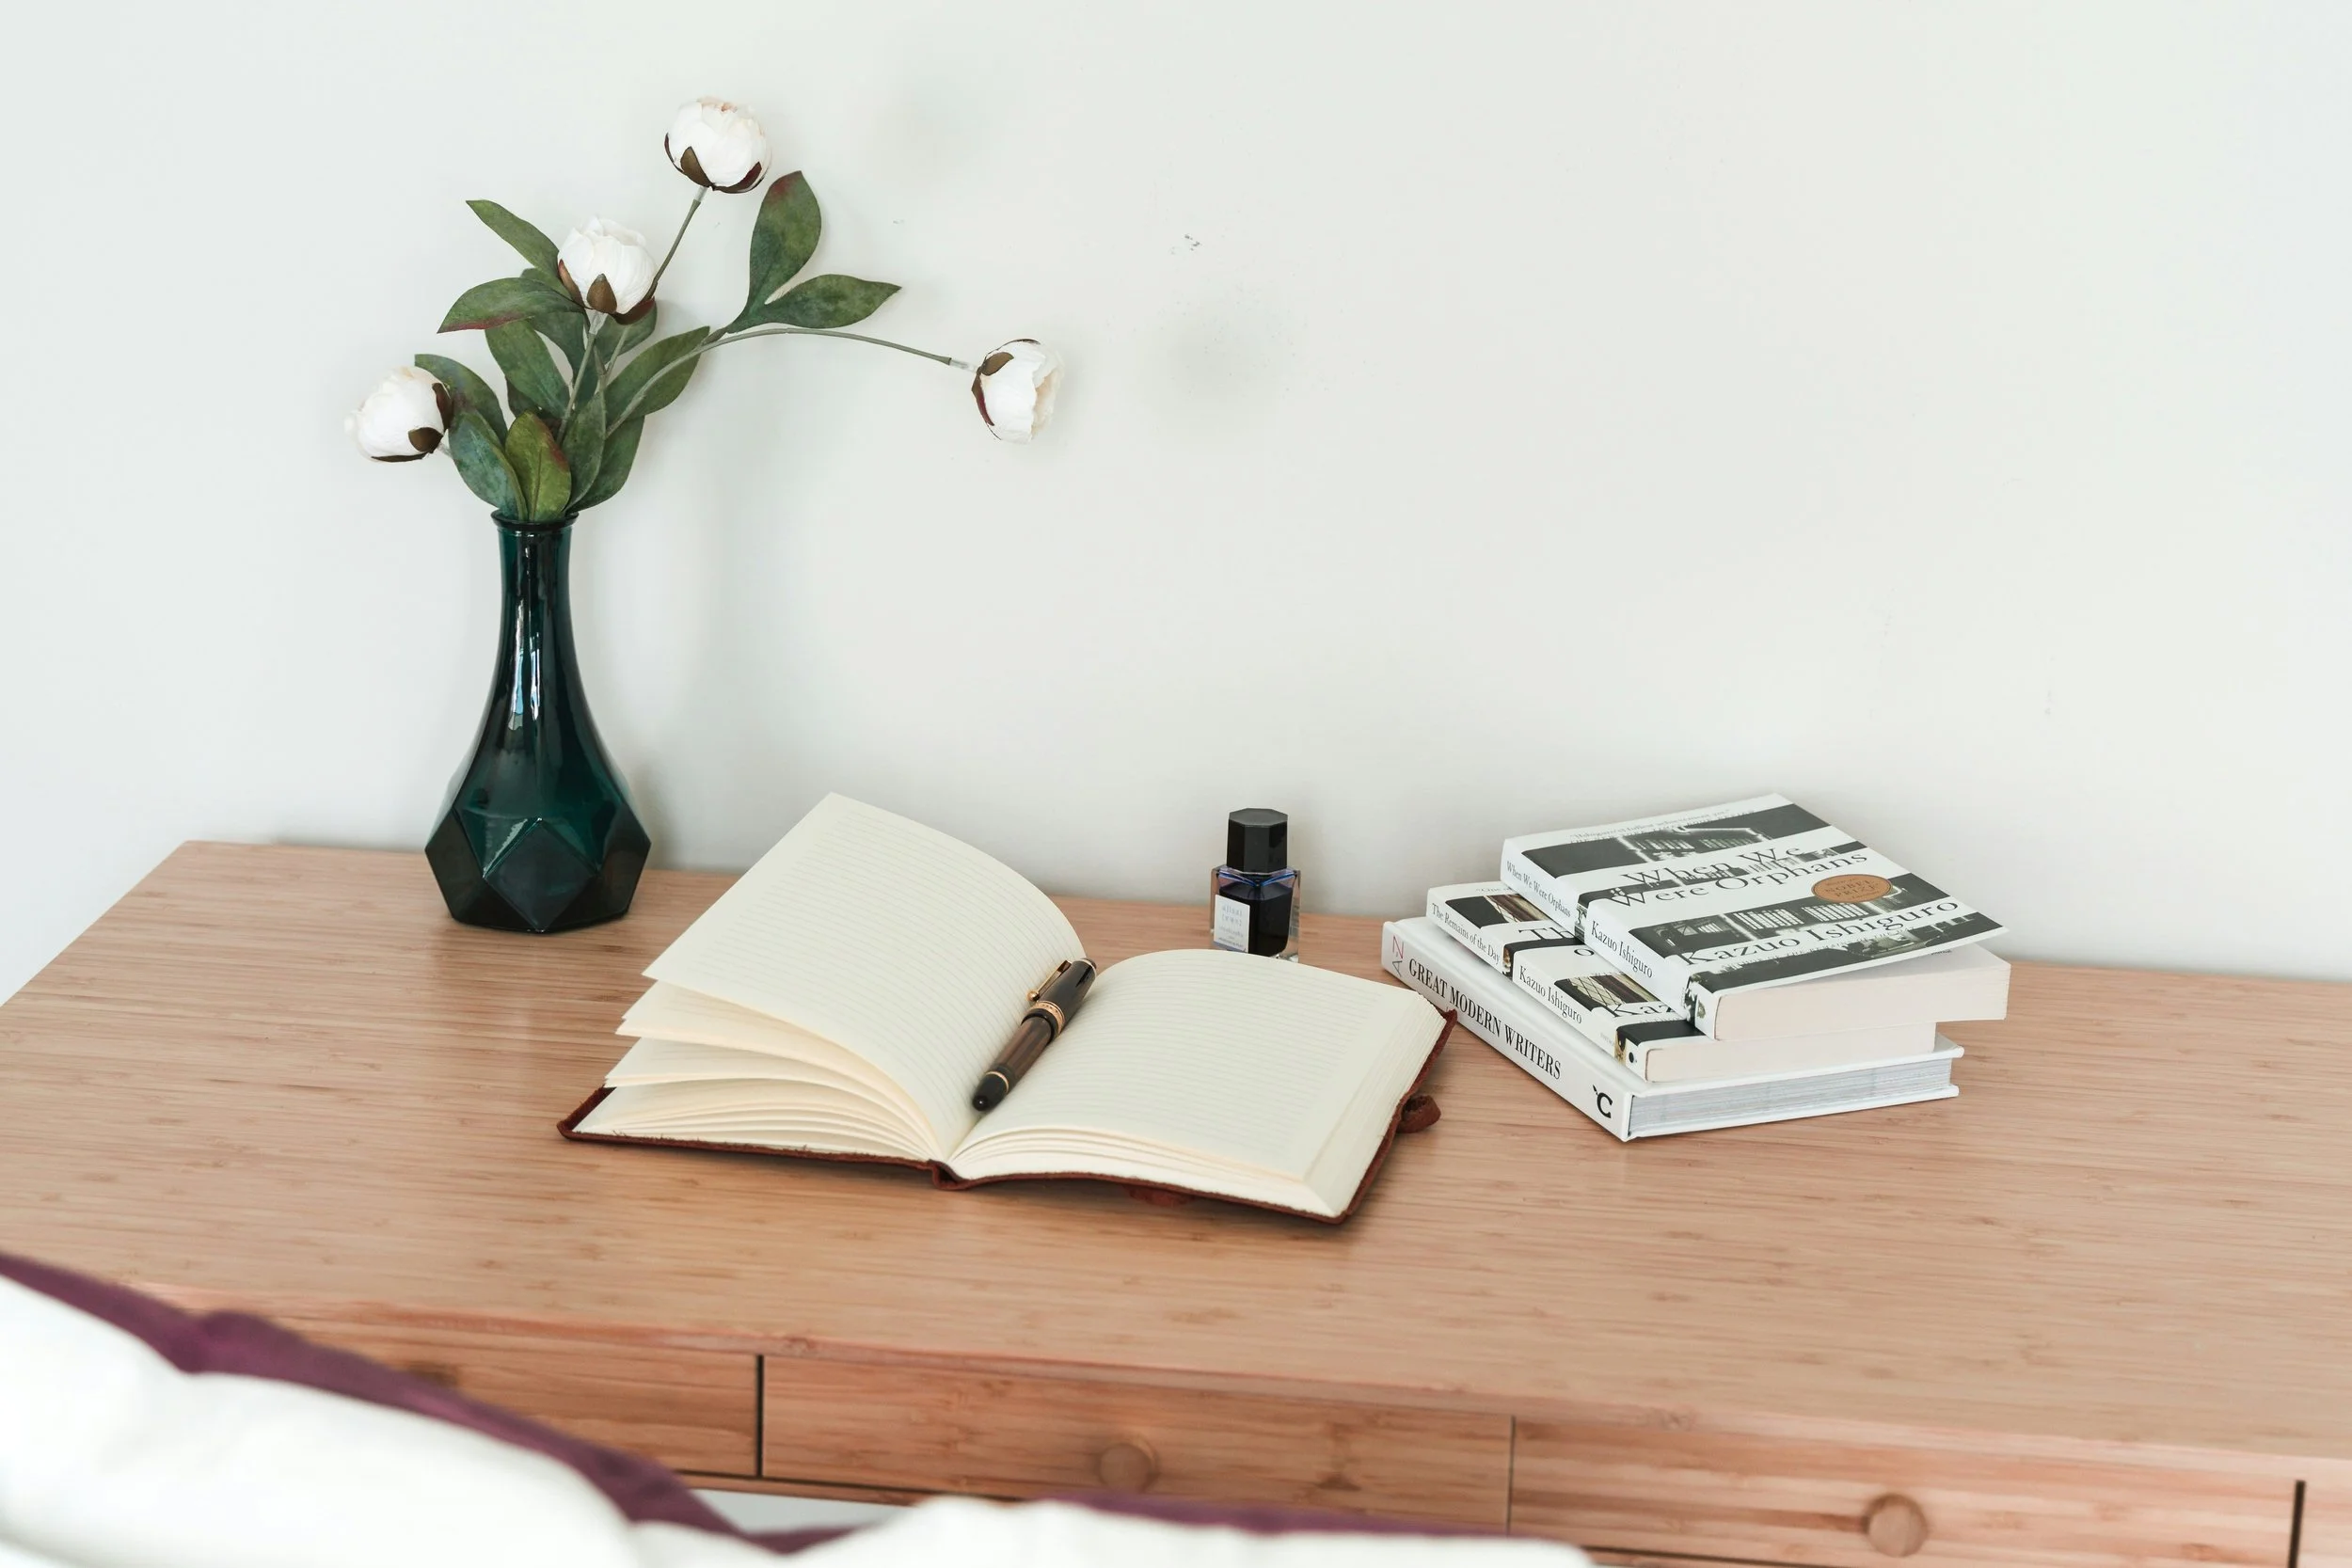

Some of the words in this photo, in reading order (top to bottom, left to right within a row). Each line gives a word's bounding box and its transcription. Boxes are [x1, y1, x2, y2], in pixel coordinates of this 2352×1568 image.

[1506, 860, 1522, 881] When
[1523, 873, 1533, 888] We
[1534, 880, 1548, 900] Were
[1548, 893, 1571, 917] Orphans
[1610, 885, 1710, 907] Were
[1715, 852, 1868, 890] Orphans
[1621, 861, 1733, 886] When
[1739, 846, 1803, 866] We
[1431, 902, 1444, 921] The
[1444, 915, 1470, 941] Remains
[1470, 932, 1478, 946] of
[1477, 937, 1487, 953] the
[1487, 944, 1501, 967] Day
[1518, 927, 1574, 941] Th
[1591, 920, 1617, 952] Kazuo
[1619, 943, 1653, 979] Ishiguro
[1677, 936, 1801, 966] Kazuo
[1805, 900, 1959, 942] Ishiguro
[1408, 958, 1448, 998] GREAT
[1450, 986, 1502, 1038] MODERN
[1504, 1023, 1562, 1081] WRITERS
[1519, 965, 1546, 996] Kazuo
[1547, 987, 1582, 1024] Ishiguro
